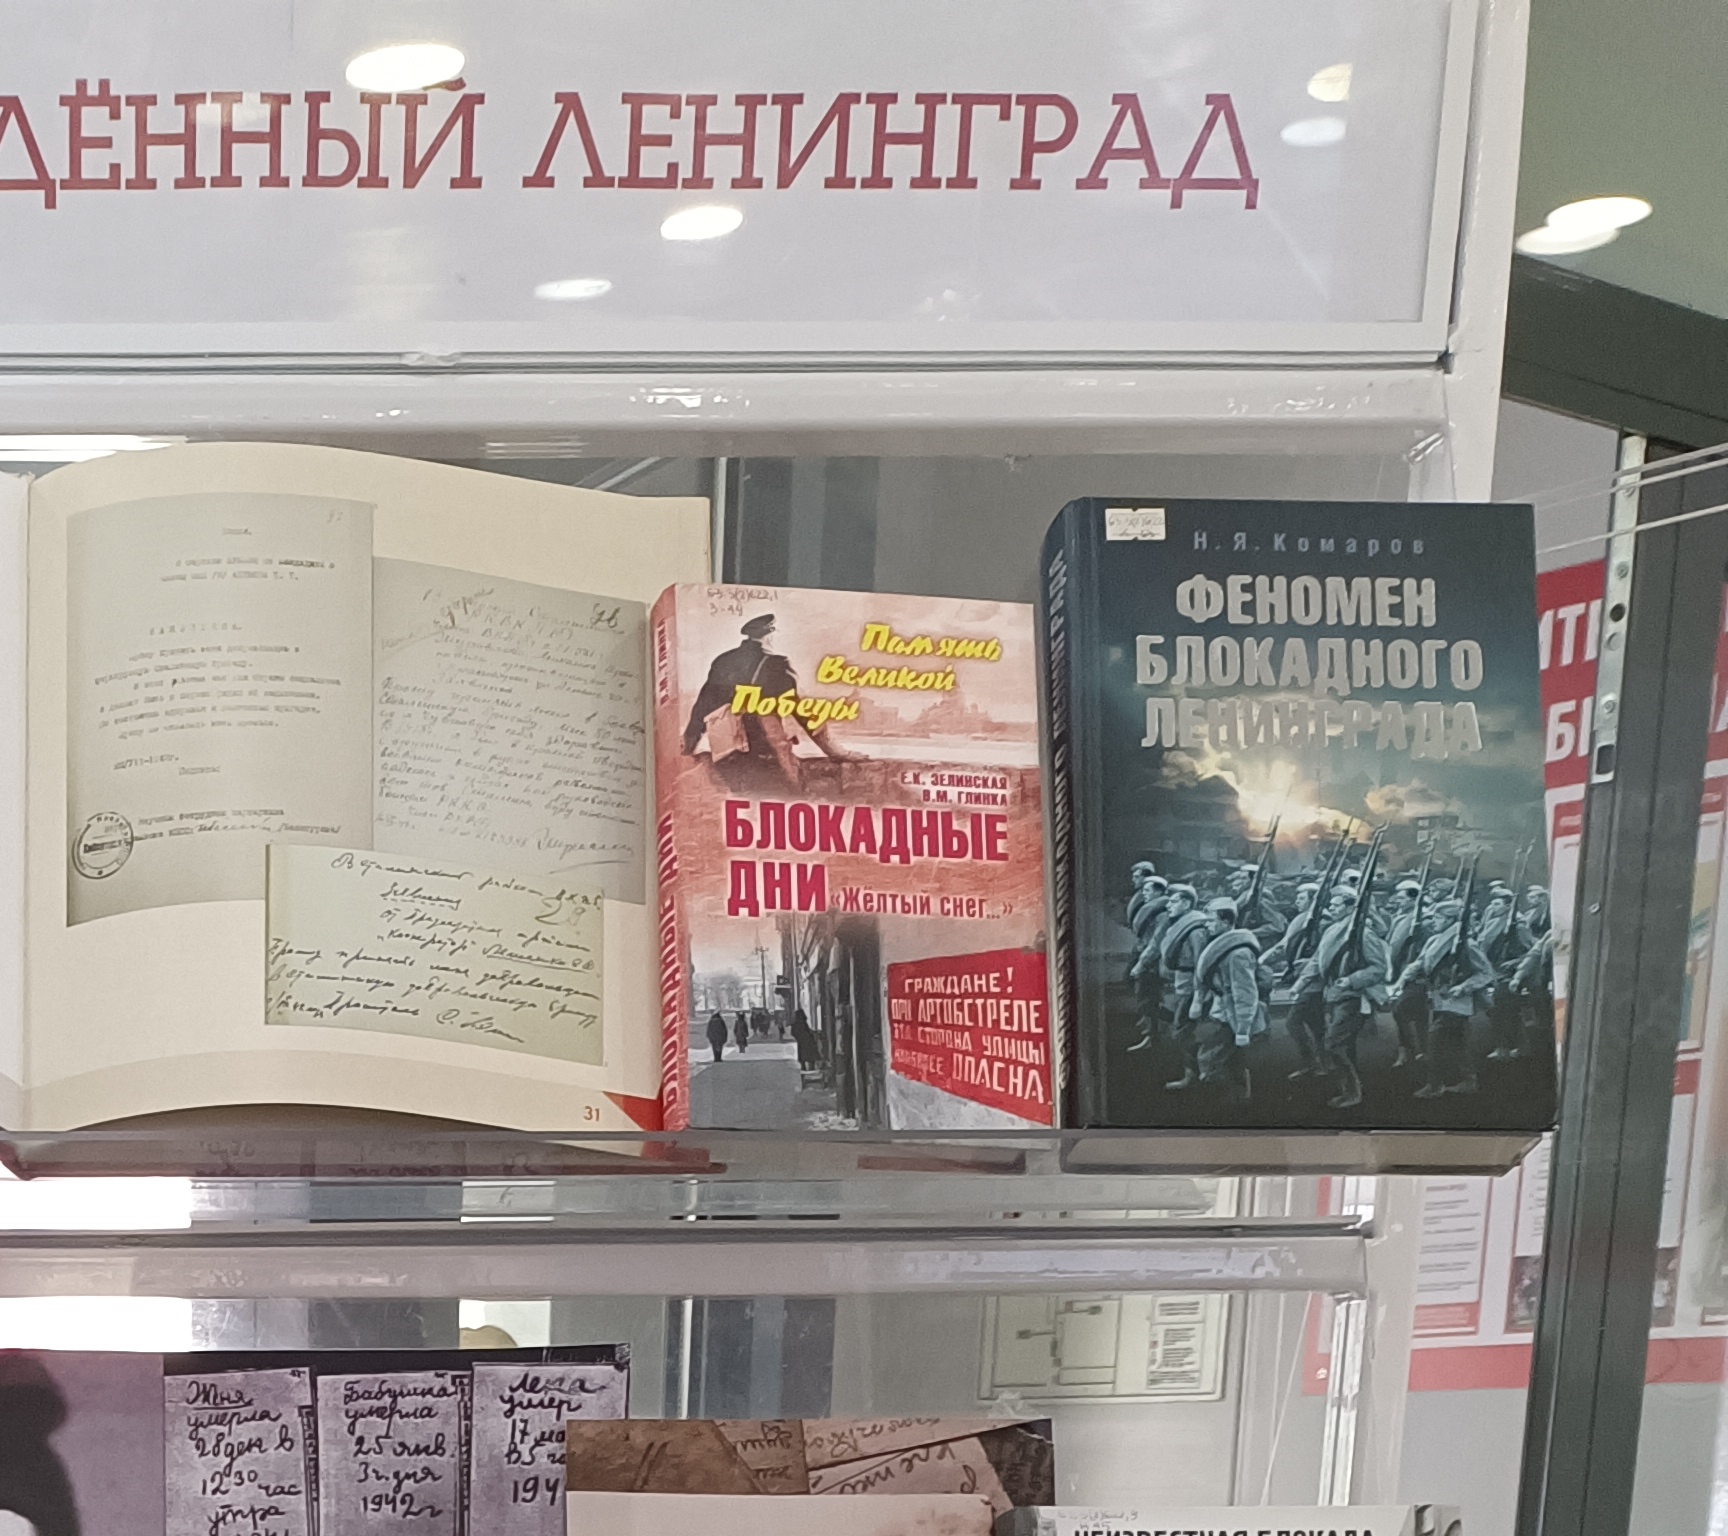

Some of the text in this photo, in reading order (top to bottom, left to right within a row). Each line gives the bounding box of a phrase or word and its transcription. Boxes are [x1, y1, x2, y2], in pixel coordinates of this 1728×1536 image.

[522, 92, 1259, 210] ЛЕНИНГРАД
[1272, 531, 1426, 557] Комаров
[1176, 573, 1437, 628] ФЕНОМЕН
[816, 655, 957, 691] Великой
[1136, 634, 1485, 697] БЛОКАДНОГО
[1141, 697, 1484, 760] ЛЕНИНГРАДА
[931, 773, 1008, 790] ЗЕЛИНСКАЯ
[957, 791, 1008, 807] ГЛИНКА
[724, 799, 1010, 865] БЛОКАДНЫЕ
[726, 860, 827, 918] ДНИ
[918, 999, 1044, 1034] АРТОБСТРЕЛЕ
[582, 1105, 602, 1122] 31
